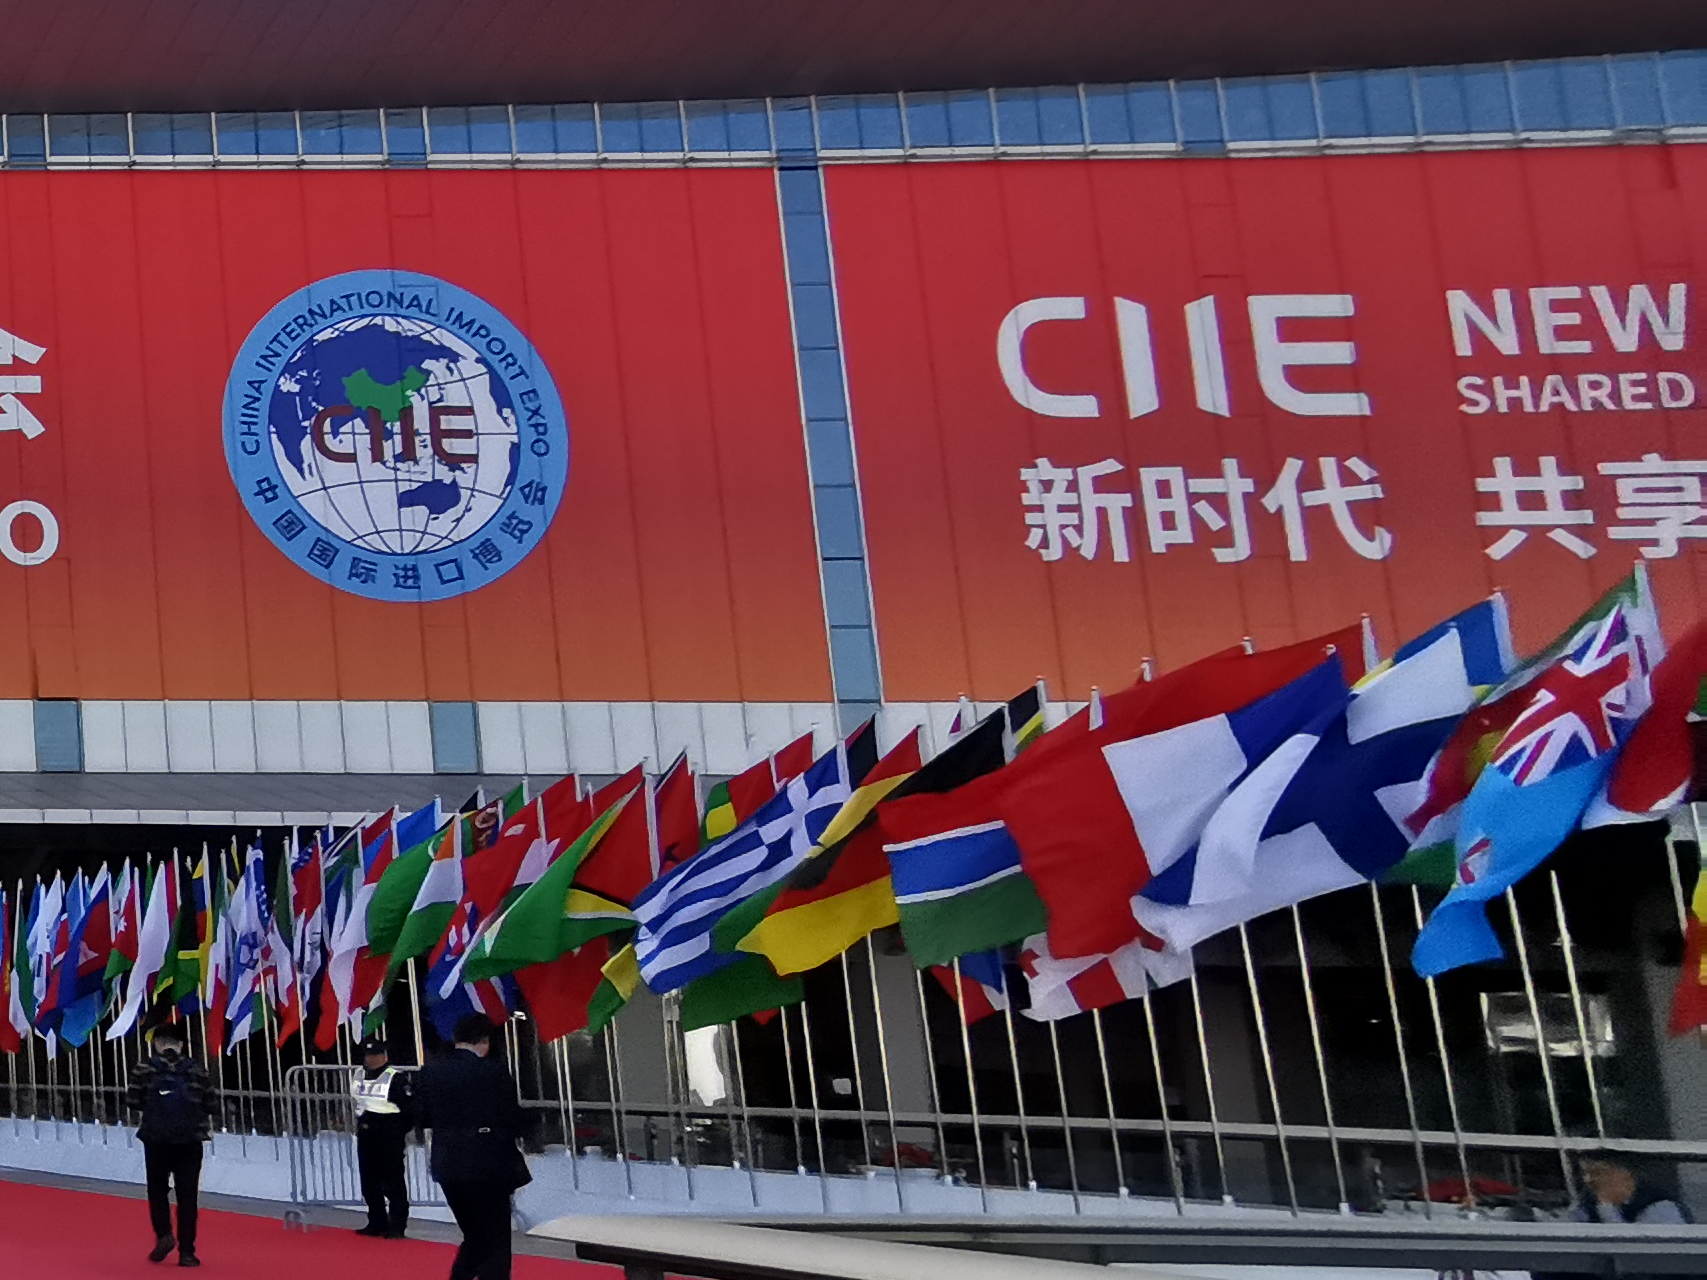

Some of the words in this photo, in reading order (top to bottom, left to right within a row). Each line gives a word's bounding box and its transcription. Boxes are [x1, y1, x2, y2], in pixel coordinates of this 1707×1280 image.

[240, 379, 266, 455] CHINA
[255, 290, 438, 372] INTERNATIONAL
[446, 307, 529, 384] IMPORT
[519, 388, 549, 458] EXPO
[997, 294, 1371, 419] CIIE
[1446, 282, 1687, 357] NEW
[312, 405, 479, 463] CIIE
[1456, 371, 1695, 414] SHARED
[254, 477, 548, 590] 中国国际进口博览会
[1019, 457, 1392, 563] 新时代
[1475, 453, 1707, 561] 共享
